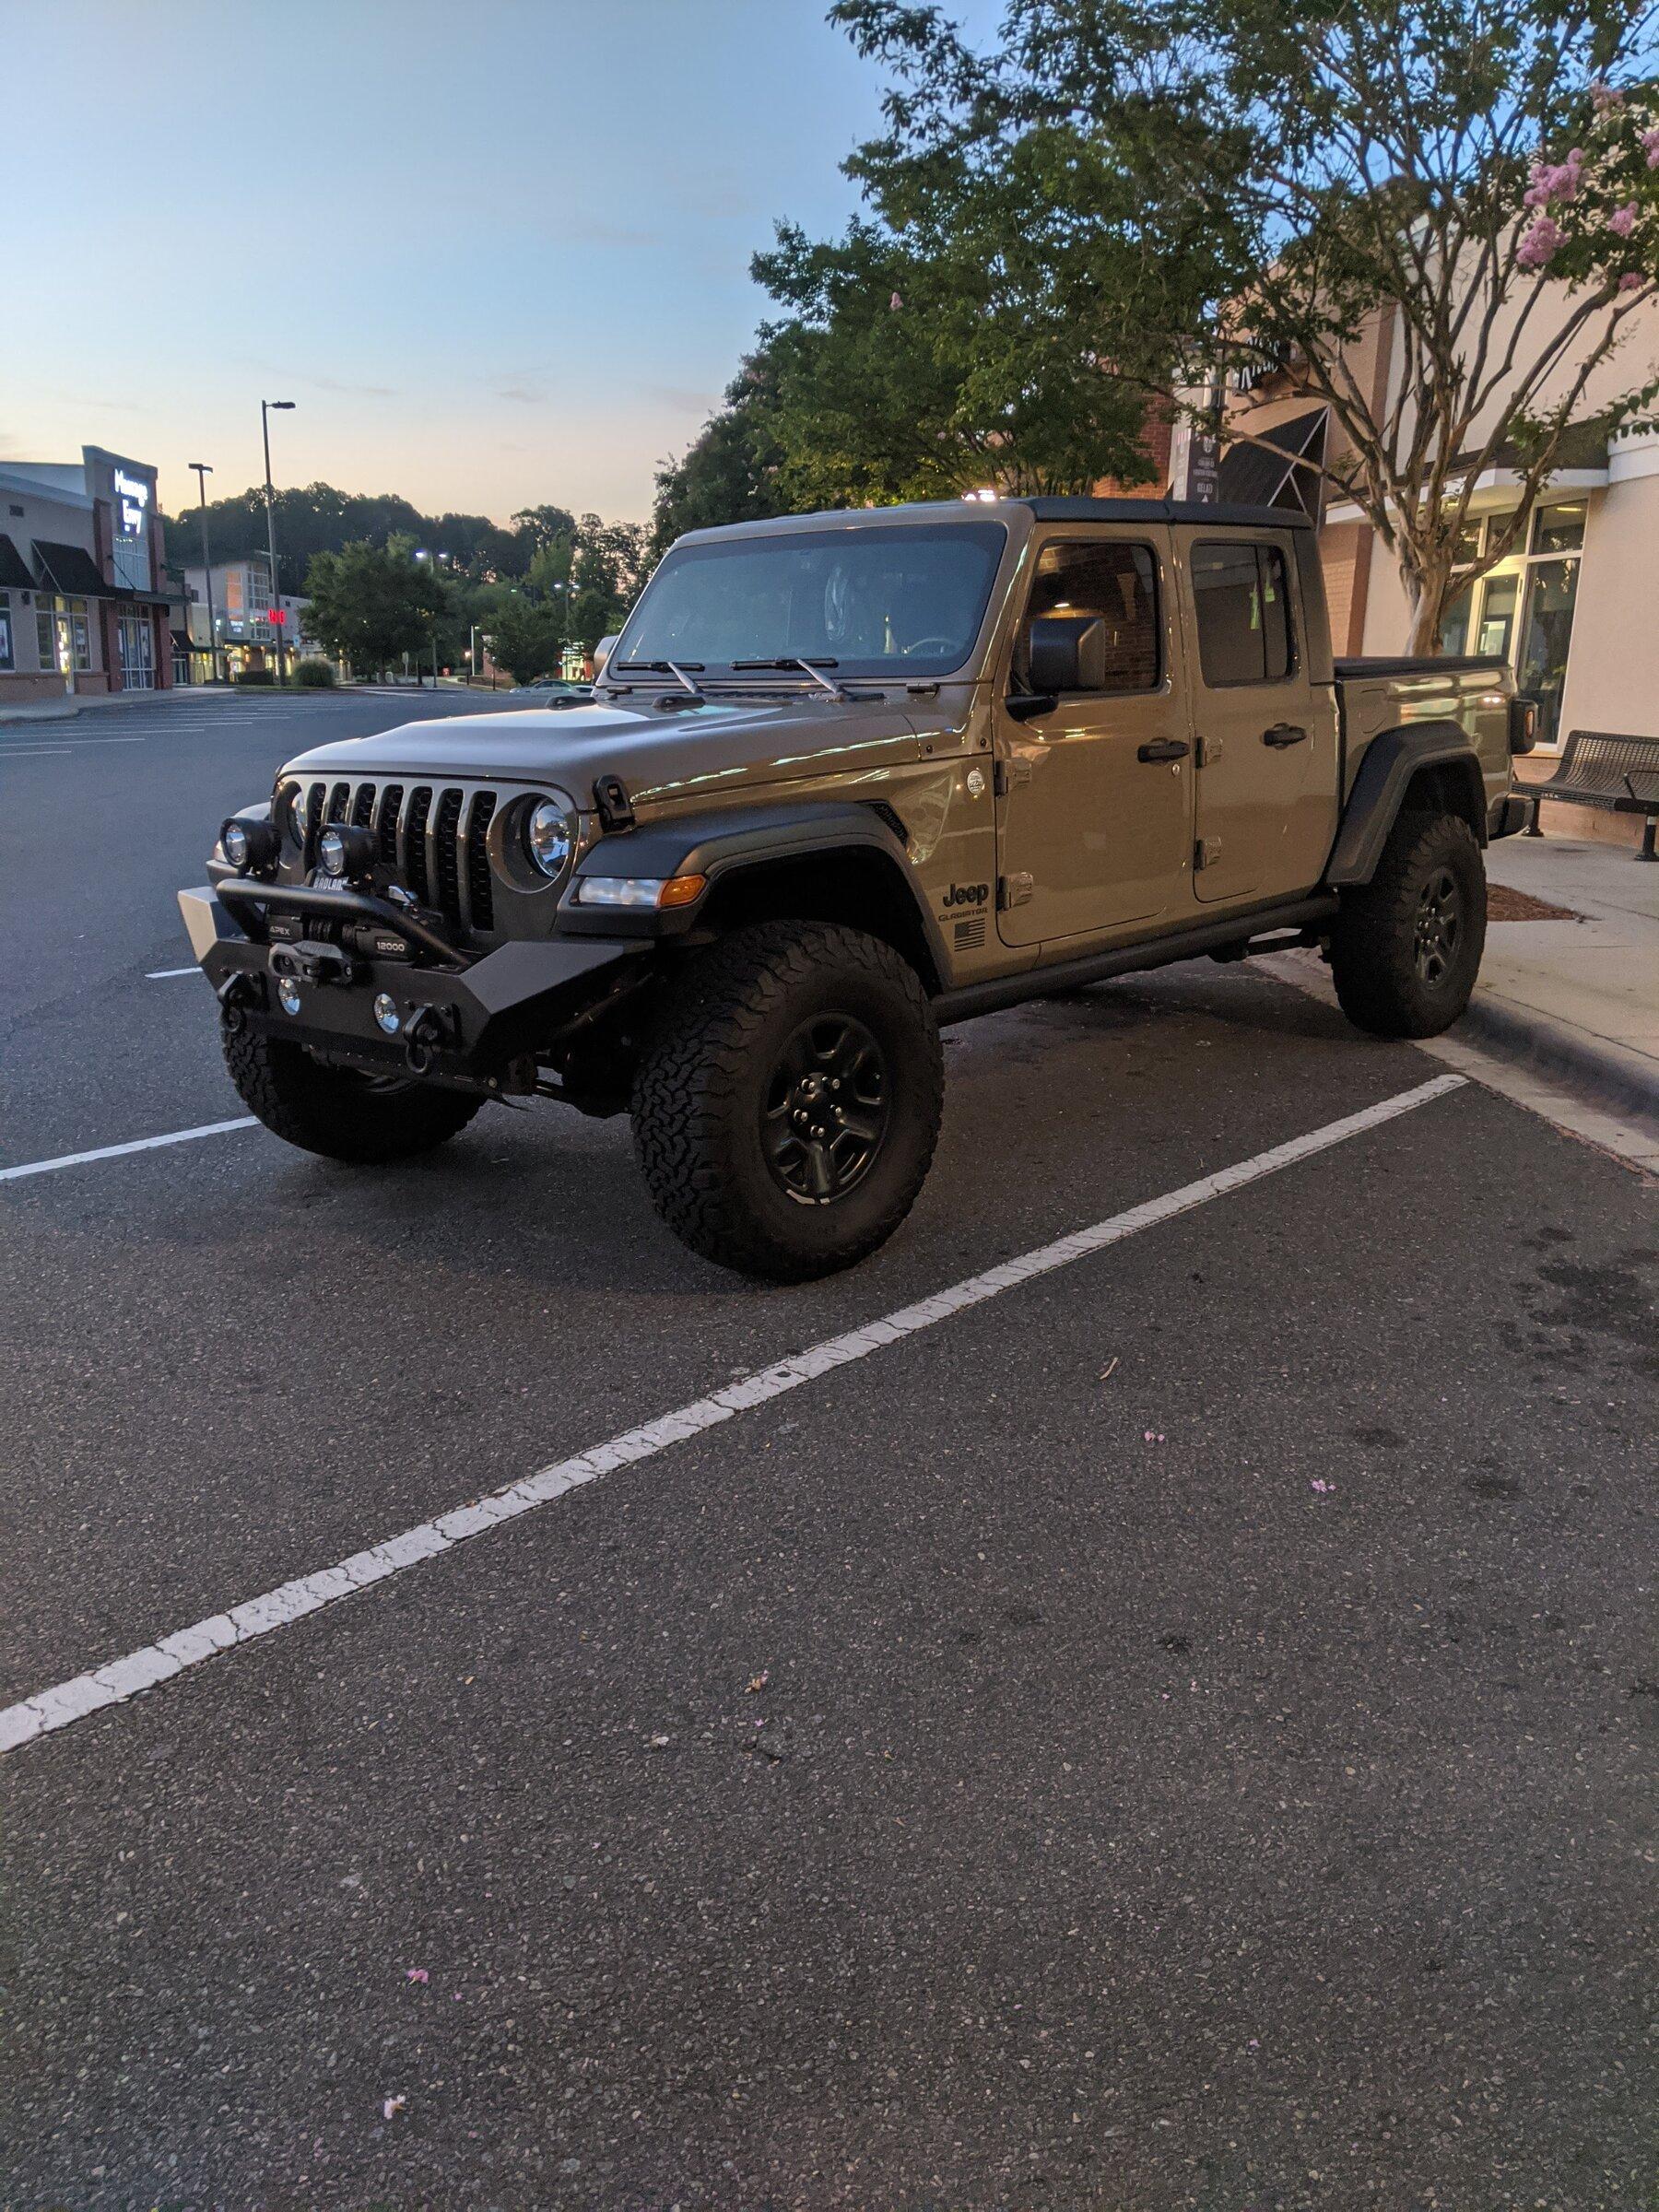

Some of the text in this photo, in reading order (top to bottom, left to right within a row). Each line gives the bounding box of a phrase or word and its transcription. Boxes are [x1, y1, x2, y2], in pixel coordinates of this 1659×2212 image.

[942, 883, 989, 907] Jeep
[938, 907, 988, 922] GLADIATOR
[269, 925, 291, 936] APEX
[376, 941, 406, 953] 12000
